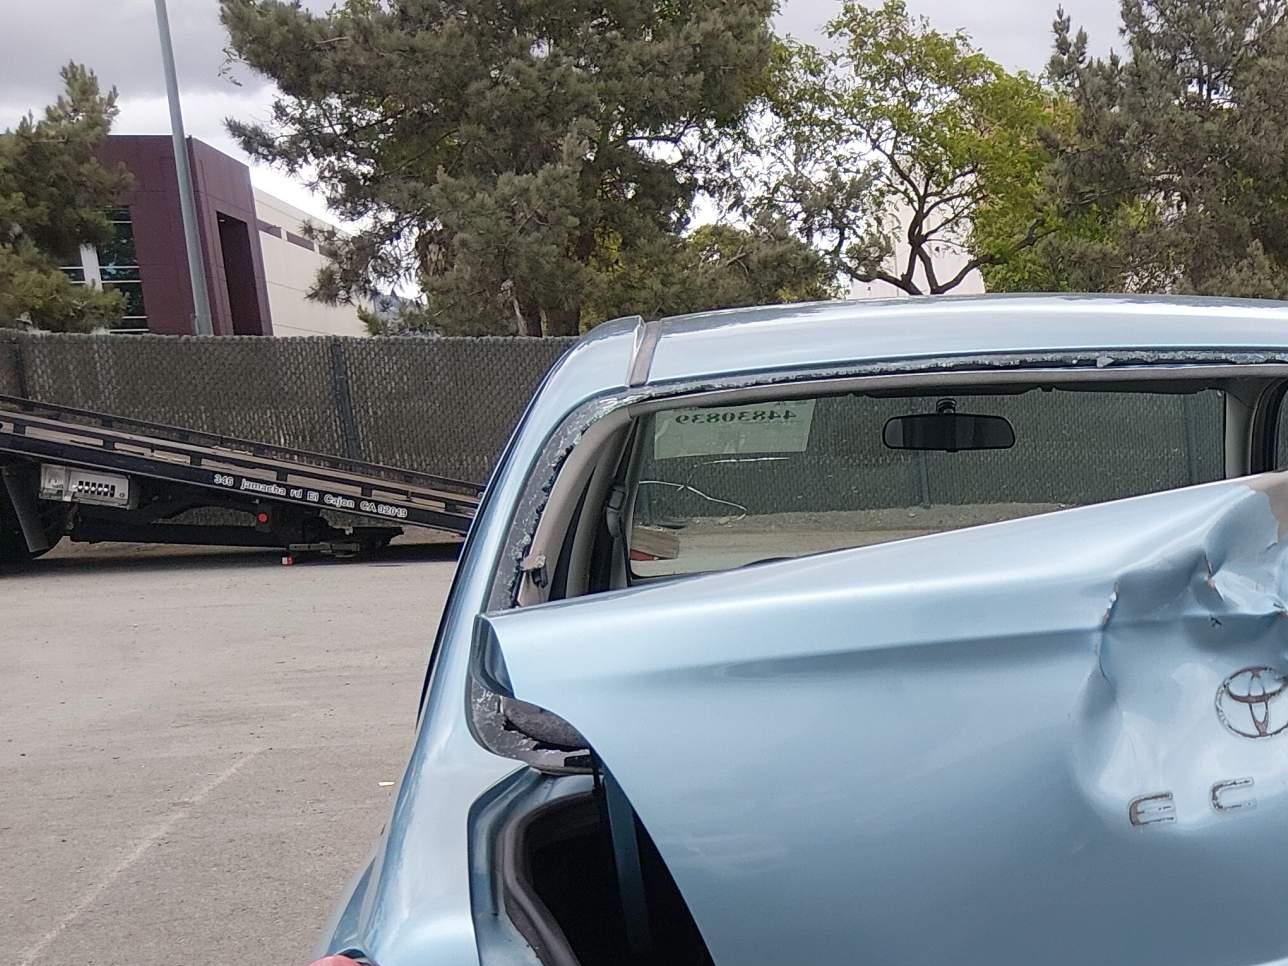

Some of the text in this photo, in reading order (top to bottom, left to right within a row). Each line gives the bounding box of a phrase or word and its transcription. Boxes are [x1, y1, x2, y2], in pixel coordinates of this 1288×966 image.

[213, 473, 234, 487] 346
[290, 488, 303, 499] rd
[323, 493, 355, 508] Cajon
[360, 500, 377, 513] CA
